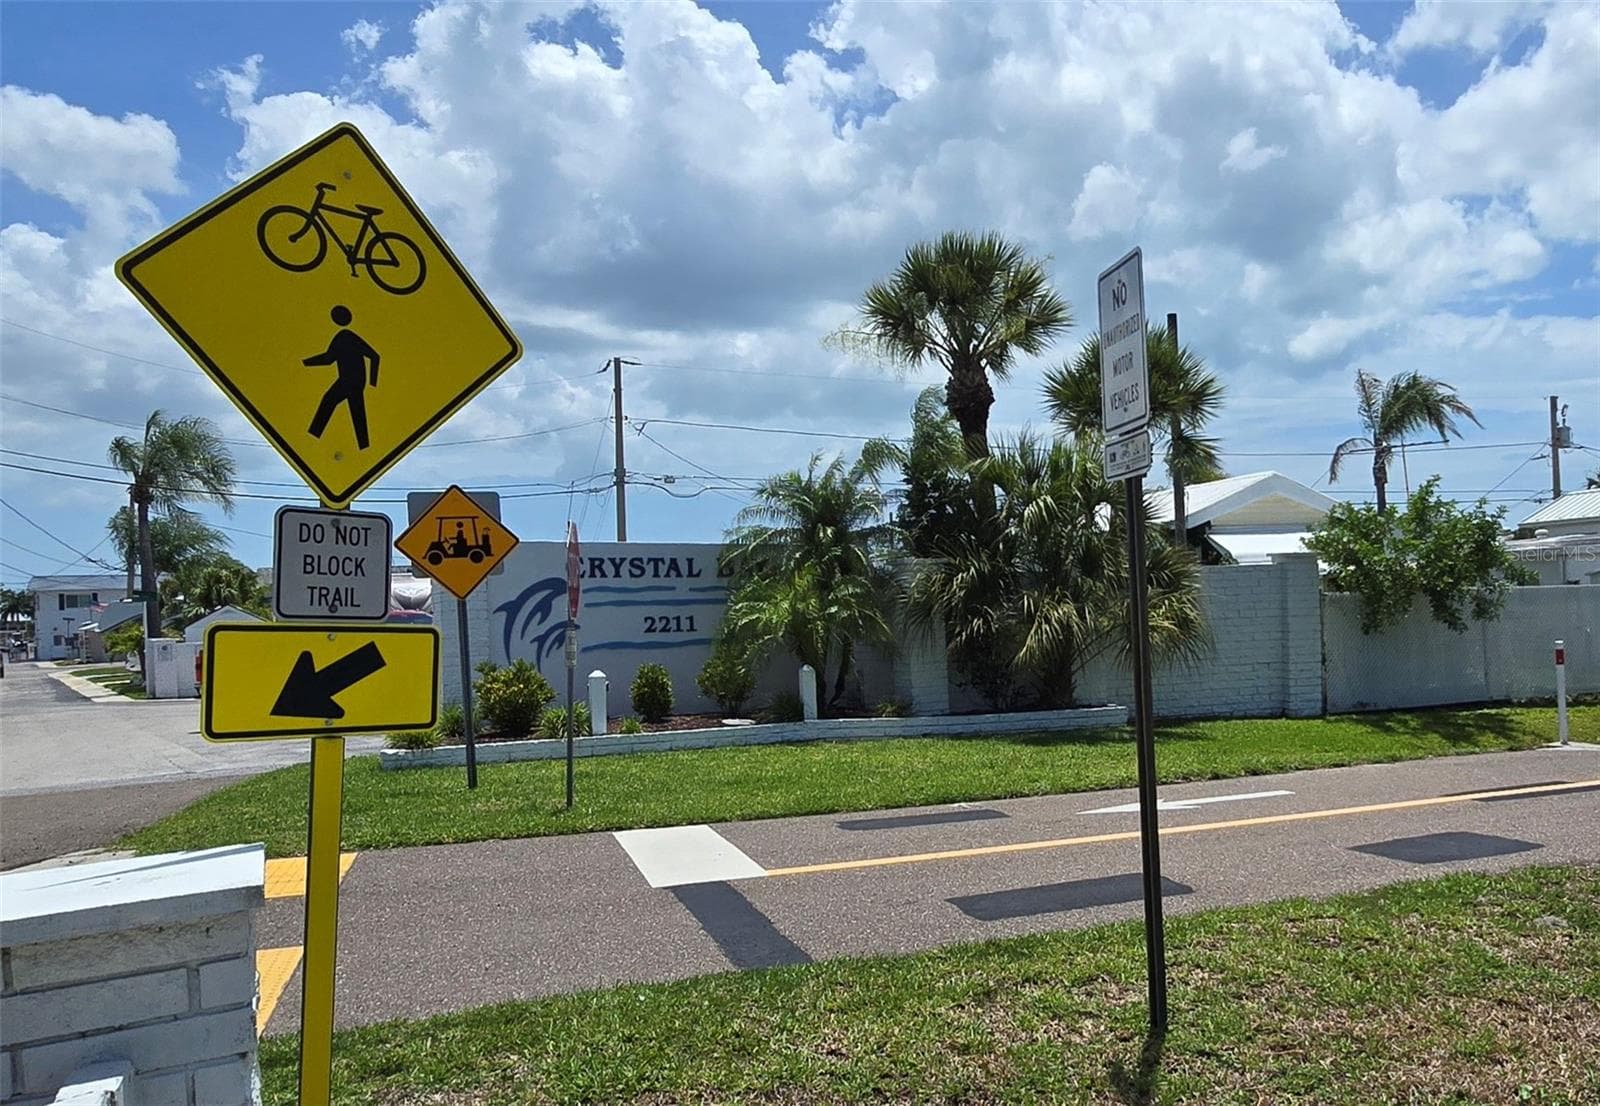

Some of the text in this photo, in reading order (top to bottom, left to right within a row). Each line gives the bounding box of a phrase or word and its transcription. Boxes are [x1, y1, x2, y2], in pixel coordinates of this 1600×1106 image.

[1112, 282, 1127, 311] NO
[1112, 352, 1133, 378] MOTOR
[1110, 383, 1139, 411] VEHICLES
[299, 523, 371, 547] DO NOT
[303, 554, 365, 577] BLOCK
[307, 586, 360, 608] TRAIL
[644, 615, 697, 633] 2211
